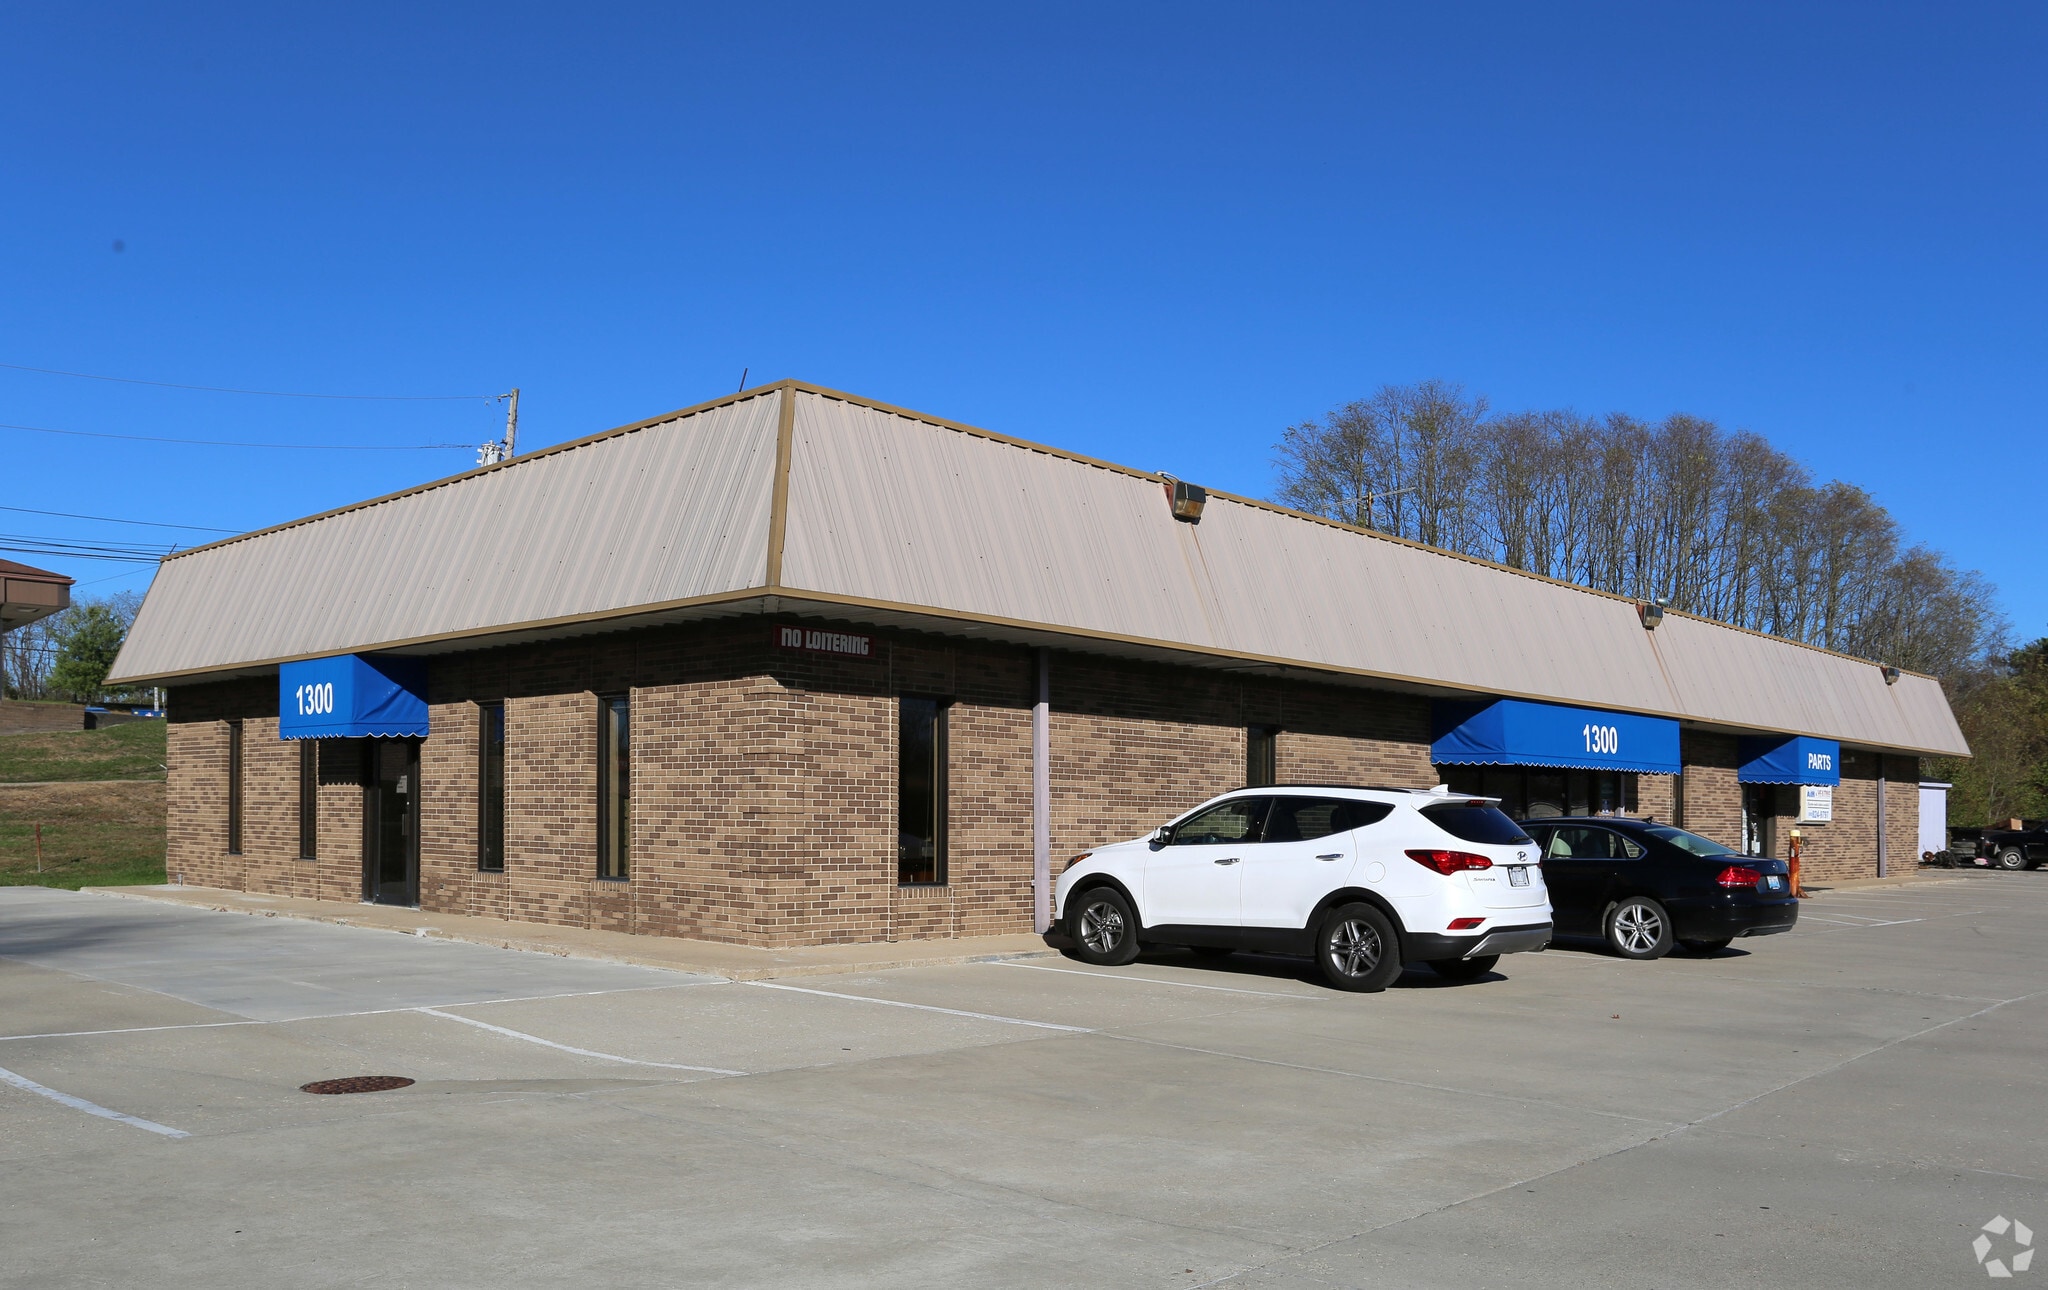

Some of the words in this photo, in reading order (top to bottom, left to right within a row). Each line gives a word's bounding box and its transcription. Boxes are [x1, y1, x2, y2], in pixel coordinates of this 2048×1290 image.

[781, 627, 802, 648] NO
[805, 630, 870, 656] LOITERING
[296, 682, 333, 716] 1300
[1583, 724, 1618, 755] 1300
[1808, 752, 1831, 771] PARTS
